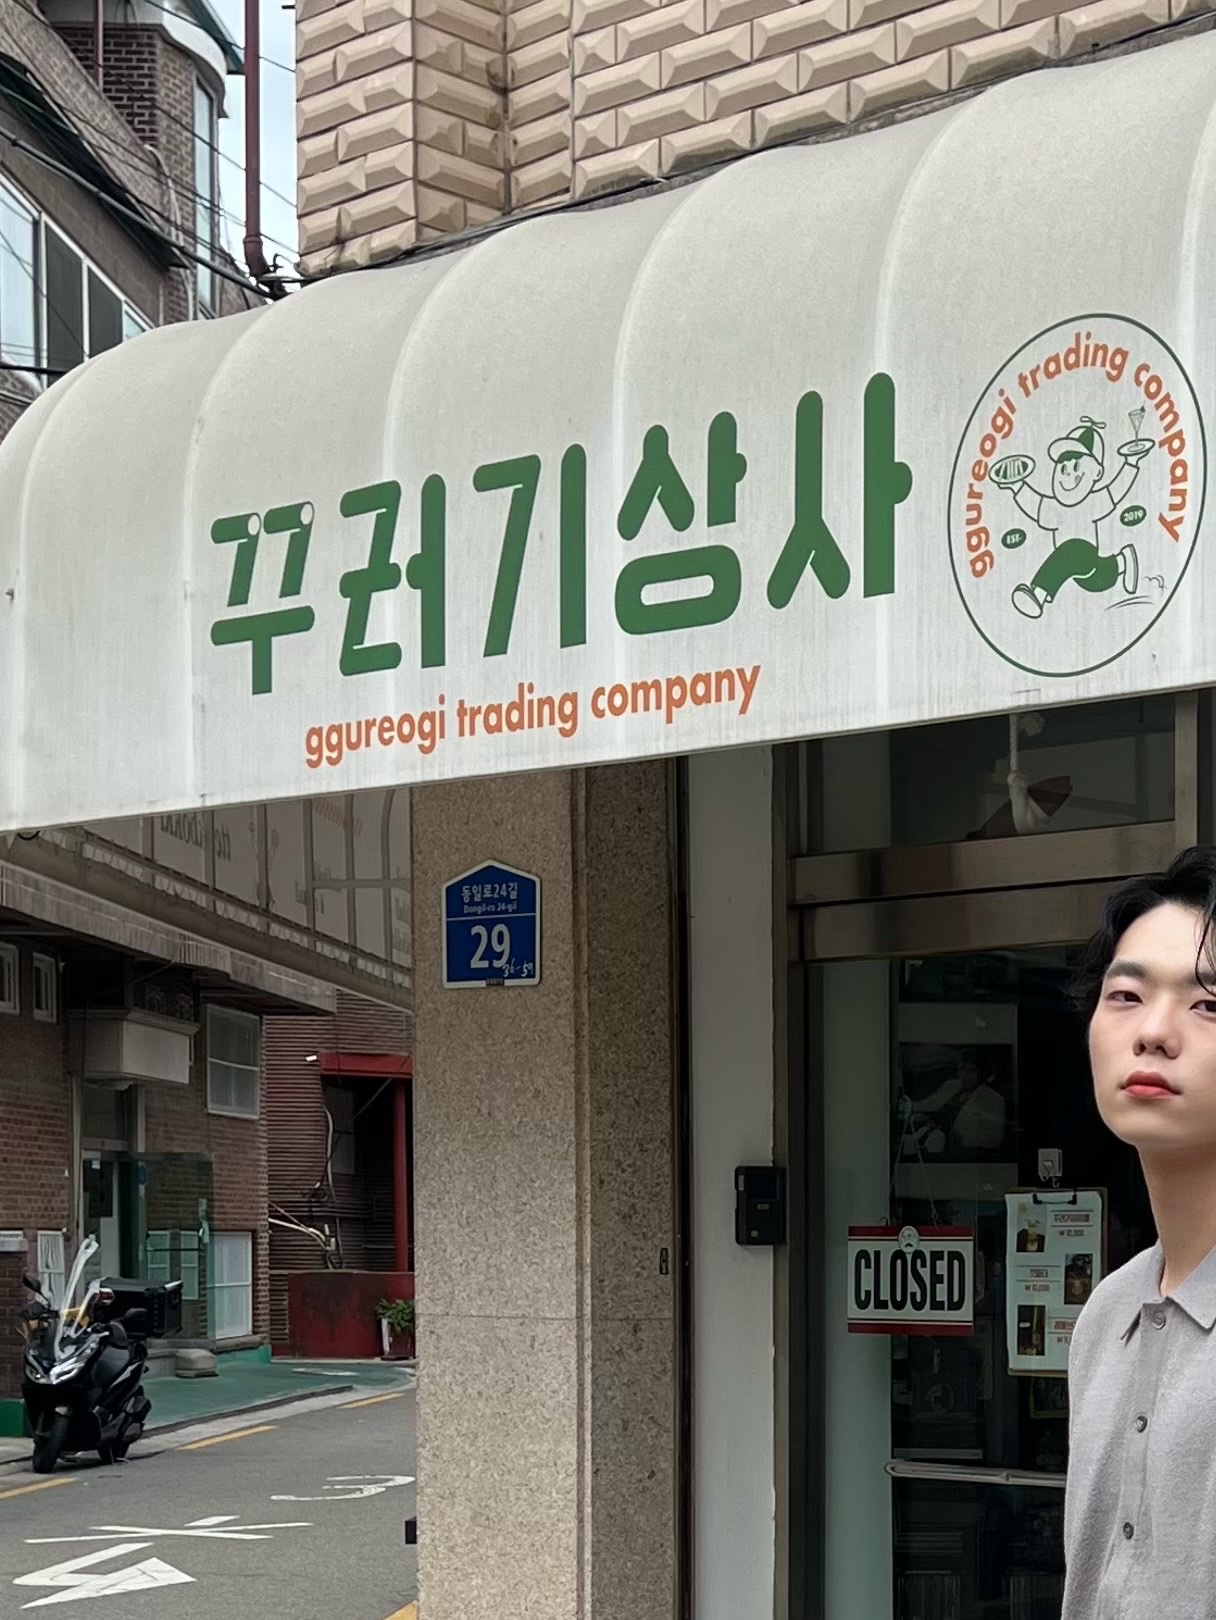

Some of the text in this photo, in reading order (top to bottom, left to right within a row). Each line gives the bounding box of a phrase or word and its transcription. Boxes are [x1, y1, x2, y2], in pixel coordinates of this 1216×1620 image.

[966, 331, 1190, 579] ggureogi trading company
[211, 372, 912, 696] 꾸러기상사
[1123, 510, 1144, 522] 2019
[304, 664, 762, 769] ggureogi trading company
[461, 882, 518, 903] 동일로24길
[470, 923, 511, 969] 29
[854, 1249, 966, 1312] CLOSED
